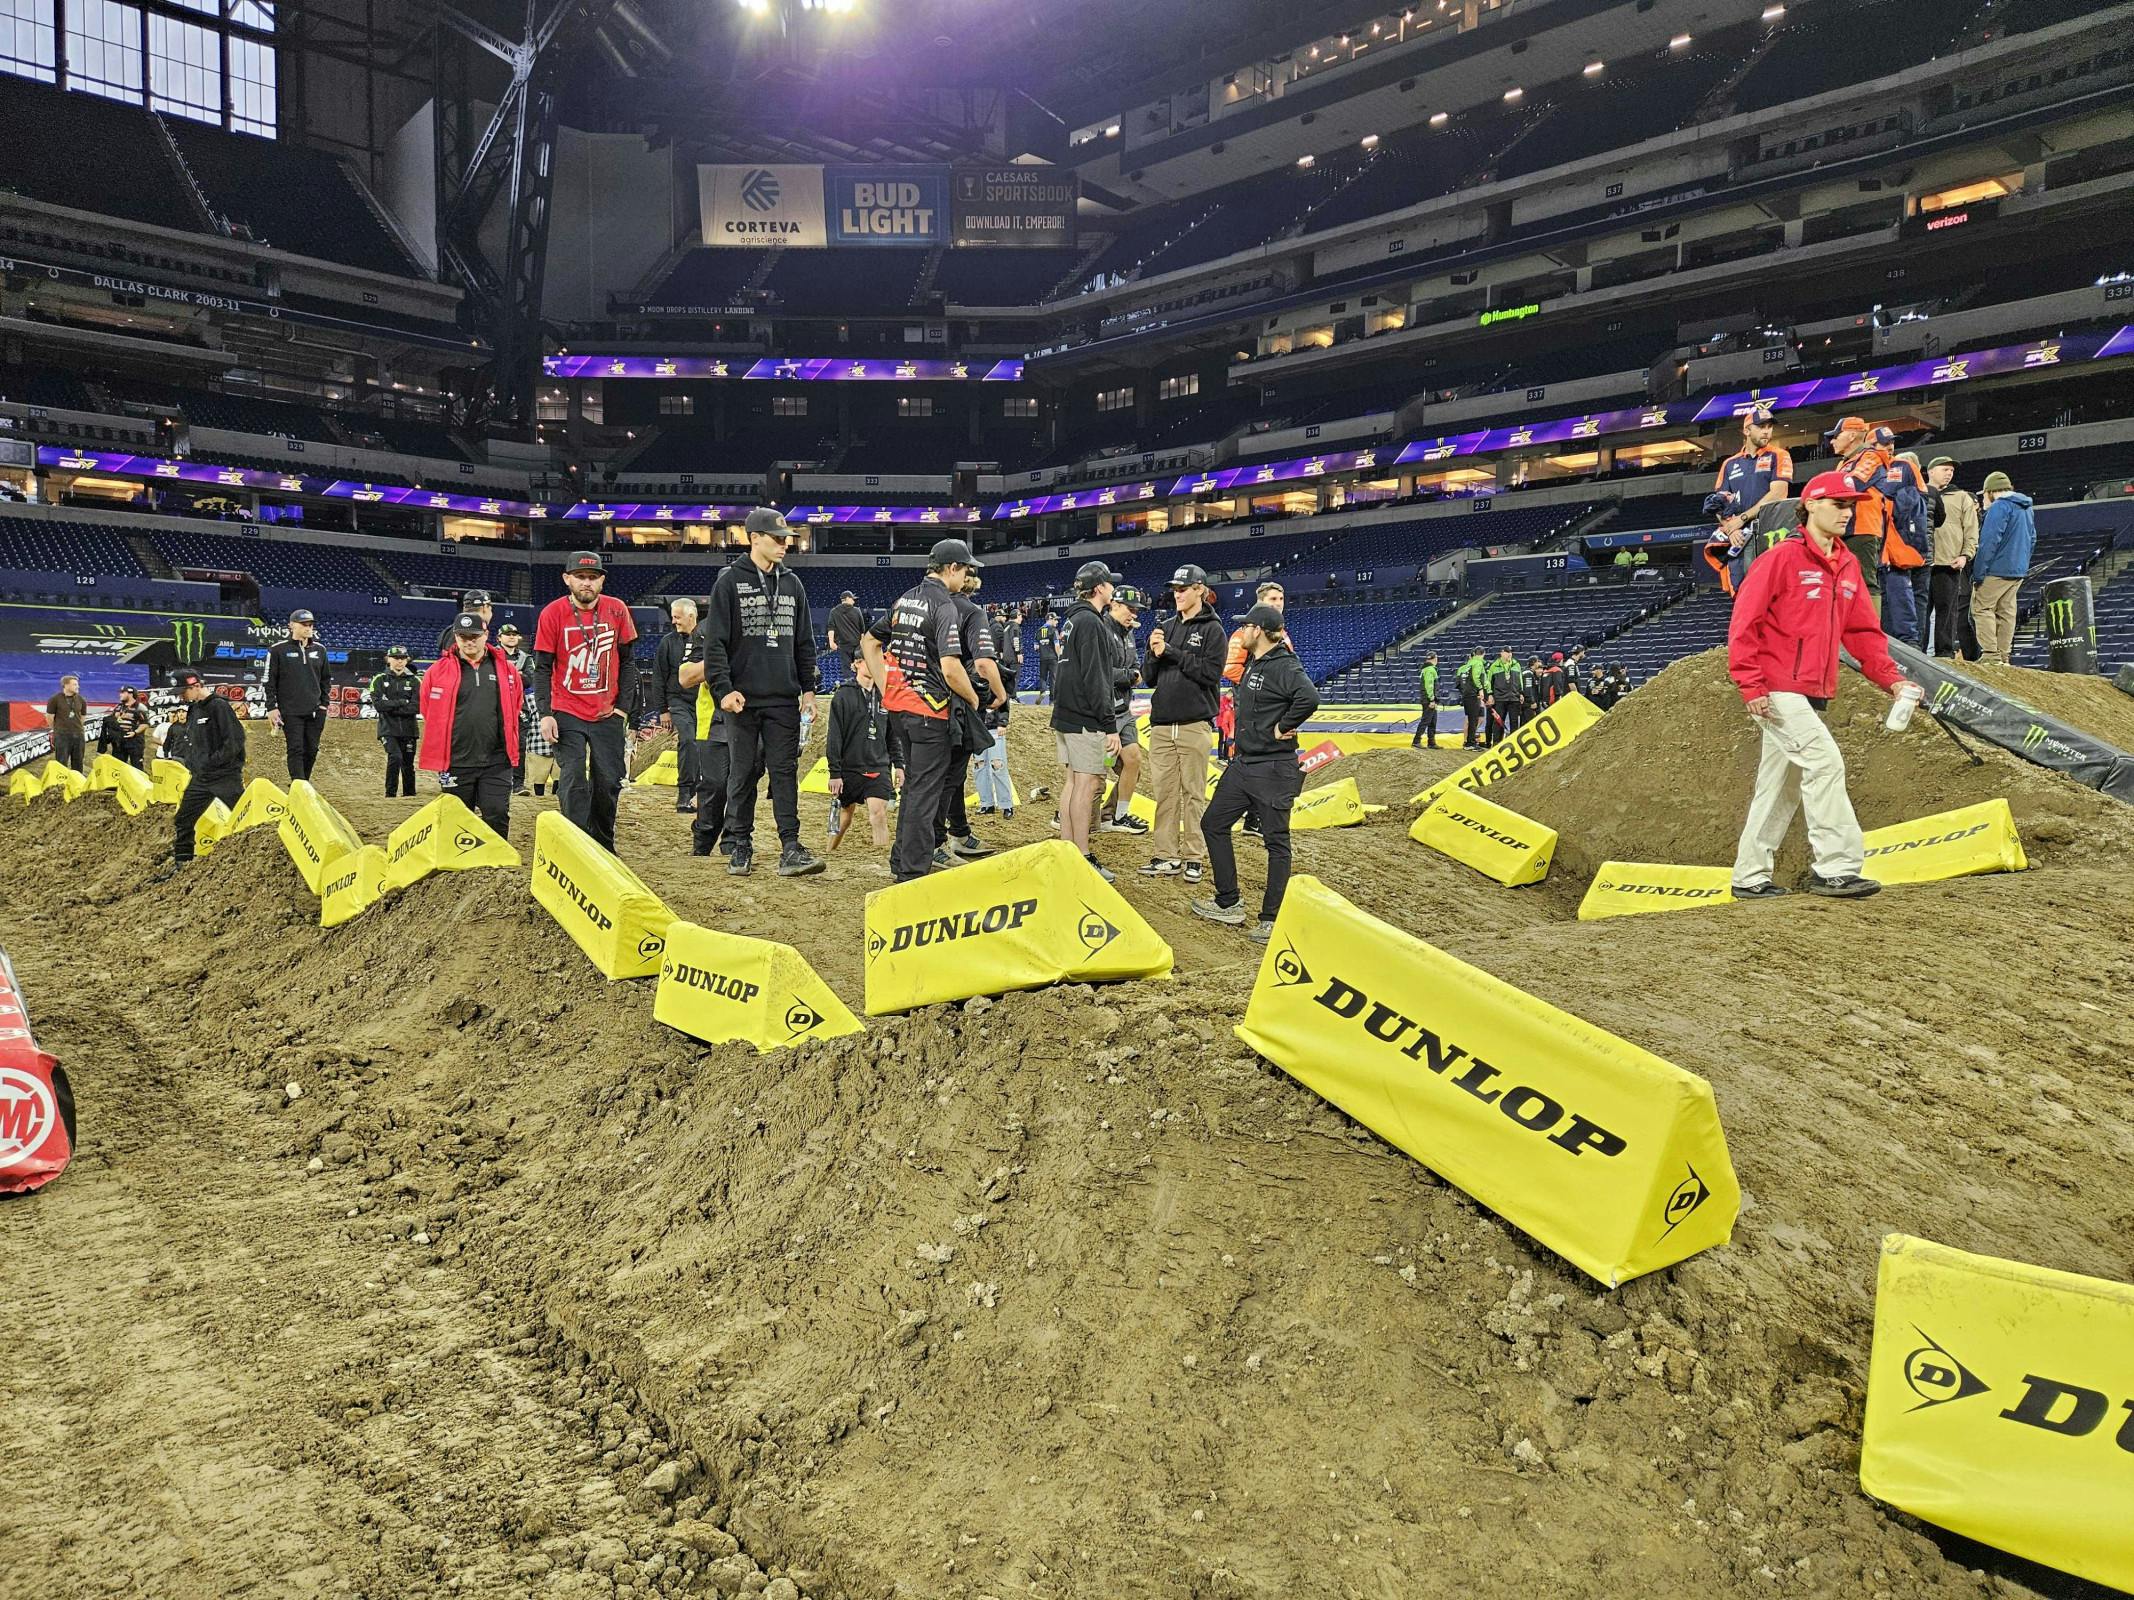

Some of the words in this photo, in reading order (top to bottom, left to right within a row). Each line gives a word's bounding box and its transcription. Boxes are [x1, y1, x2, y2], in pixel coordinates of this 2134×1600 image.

[986, 172, 1038, 183] CAESARS
[854, 183, 920, 208] BUD
[986, 185, 1074, 201] SPORTSBOOK
[1607, 185, 1622, 196] 537
[725, 221, 800, 233] CORTEVA
[842, 208, 933, 234] LIGHT
[965, 215, 1010, 229] DOWNLOAD
[1013, 215, 1023, 231] IT,
[1025, 215, 1065, 229] EMPEROR!
[1926, 212, 1968, 231] verizon
[740, 236, 788, 245] agriscience
[94, 276, 145, 294] DALLAS
[147, 286, 190, 301] CLARK
[196, 294, 240, 311] 2003-11
[2107, 286, 2132, 298] 339
[1491, 304, 1539, 322] Huntington
[1764, 350, 1784, 360] 338
[1932, 360, 1969, 379] SMX
[1528, 390, 1544, 399] 337
[2020, 437, 2045, 449] 239
[1475, 501, 1490, 510] 237
[243, 527, 259, 535] 229
[1251, 526, 1264, 535] 236
[877, 557, 890, 565] 233
[1546, 558, 1566, 569] 138
[76, 576, 95, 585] 128
[1357, 571, 1373, 581] 137
[373, 596, 389, 604] 129
[1954, 692, 1994, 717] MONSTER
[2045, 736, 2088, 762] MONSTER
[1447, 812, 1531, 850] DUNLOP
[289, 814, 321, 865] DUNLOP
[394, 823, 434, 864] DUNLOP
[325, 871, 357, 898] DUNLOP
[1615, 883, 1724, 898] DUNLOP
[546, 860, 614, 931] DUNLOP
[889, 898, 1038, 954] DUNLOP
[673, 962, 760, 1005] DUNLOP
[1313, 976, 1627, 1161] DUNLOP
